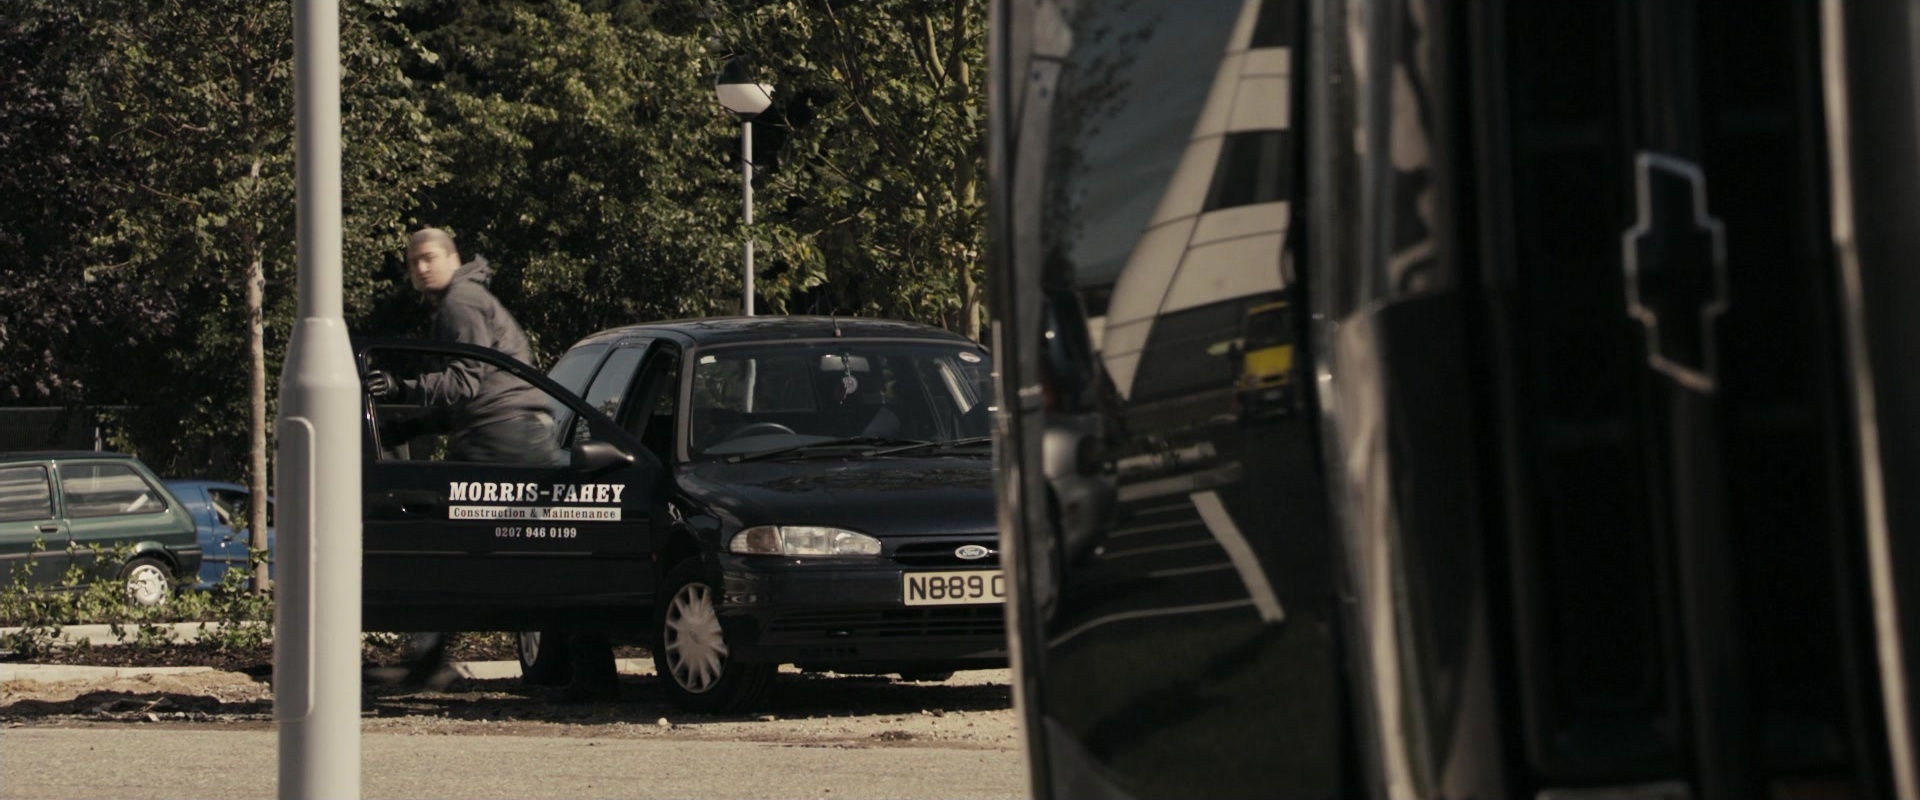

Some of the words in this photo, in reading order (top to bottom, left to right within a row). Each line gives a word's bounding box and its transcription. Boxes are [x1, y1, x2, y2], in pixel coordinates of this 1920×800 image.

[449, 482, 625, 503] MORRIS-FAHEY
[454, 507, 525, 518] Construction
[530, 508, 537, 518] &
[542, 508, 616, 518] Maintenance
[496, 527, 522, 538] 0207
[525, 527, 545, 538] 946
[549, 527, 577, 538] 0199
[909, 575, 984, 600] N889
